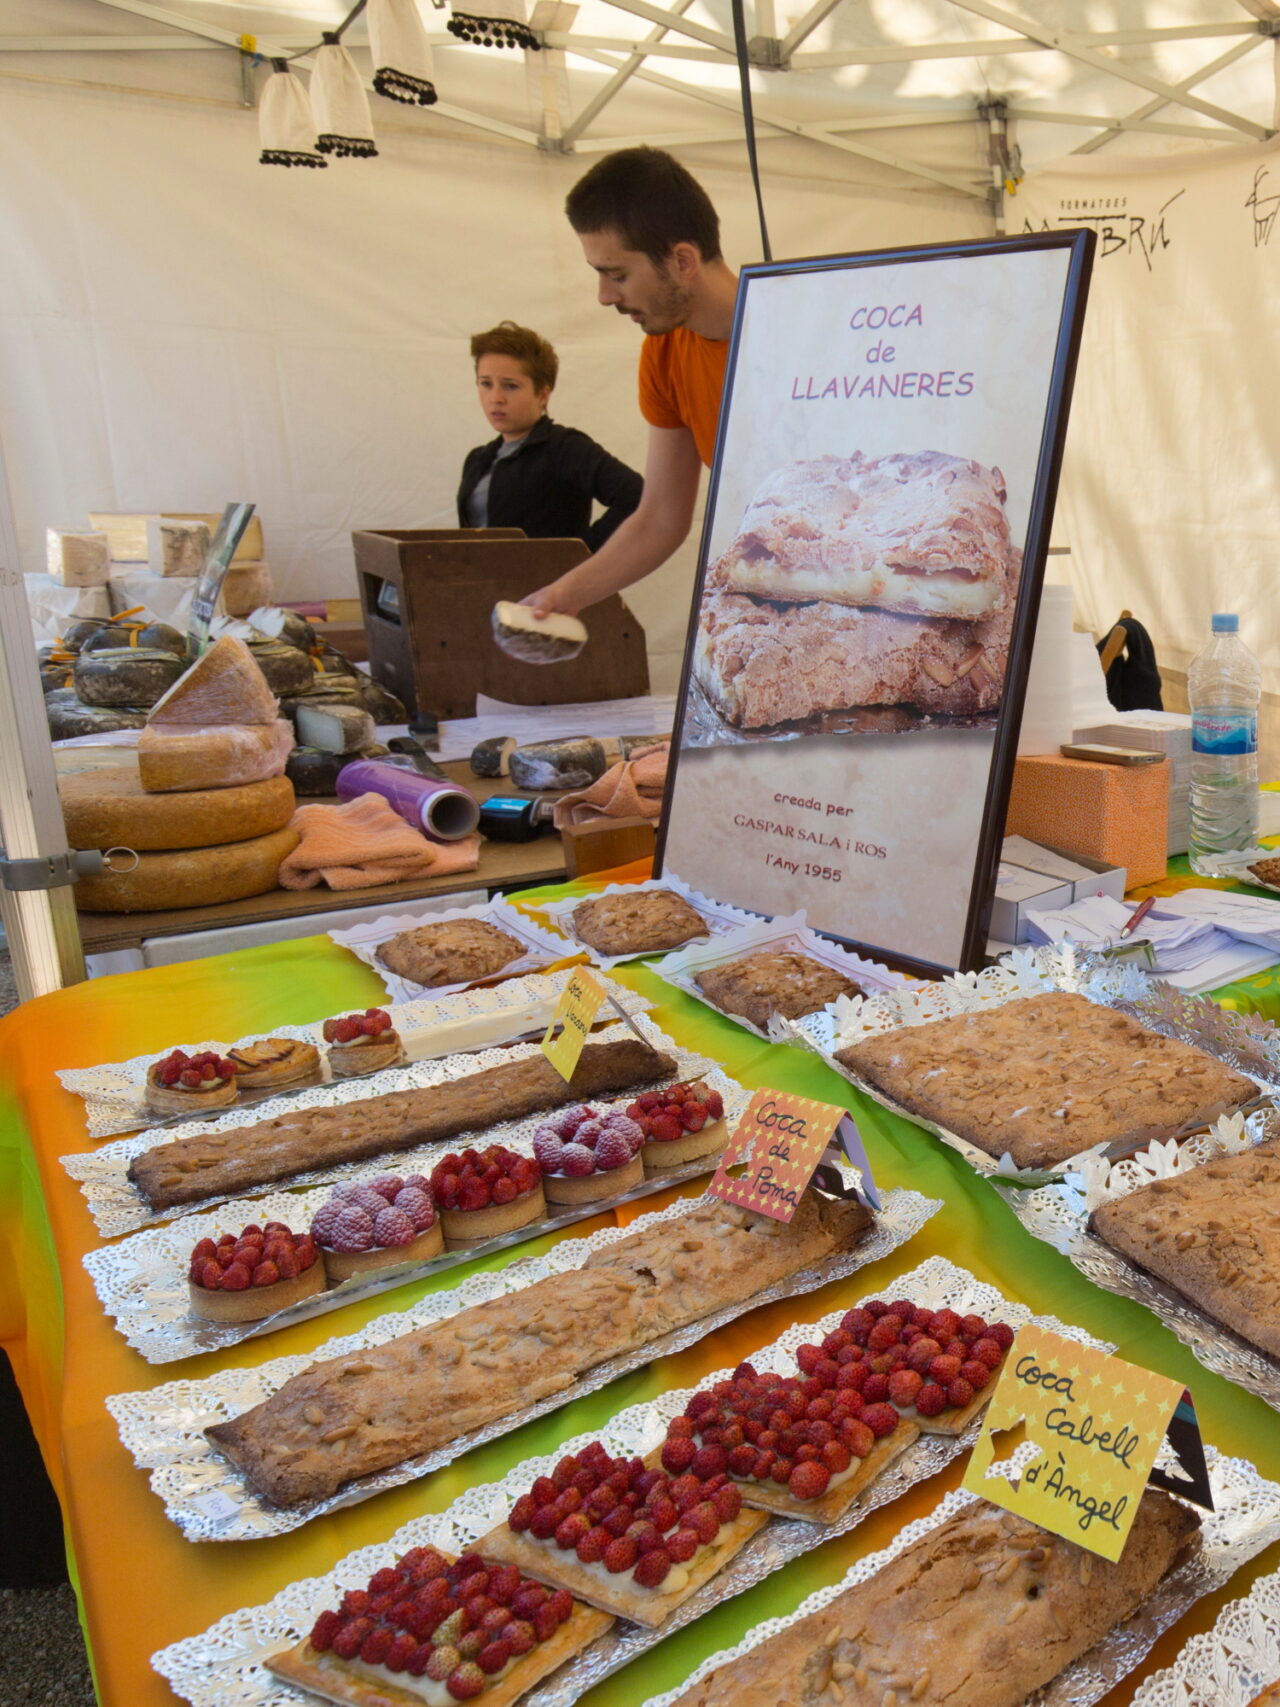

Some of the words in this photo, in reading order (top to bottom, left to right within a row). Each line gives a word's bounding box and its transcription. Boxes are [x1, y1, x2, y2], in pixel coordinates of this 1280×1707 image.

[850, 303, 923, 330] COCA
[866, 339, 896, 364] de
[791, 371, 975, 400] LLAVANERES
[773, 792, 822, 812] creada
[825, 803, 854, 817] per
[733, 813, 795, 839] GASPAR
[796, 828, 841, 849] SALA
[854, 841, 888, 859] ROS
[765, 853, 800, 875] l'Any
[804, 863, 842, 883] 1955
[756, 1101, 808, 1139] Coca
[768, 1140, 790, 1162] de
[752, 1166, 799, 1207] Poma
[1015, 1356, 1075, 1402] Coca
[1045, 1407, 1139, 1469] Cabell
[1024, 1451, 1129, 1531] d'Àngel
